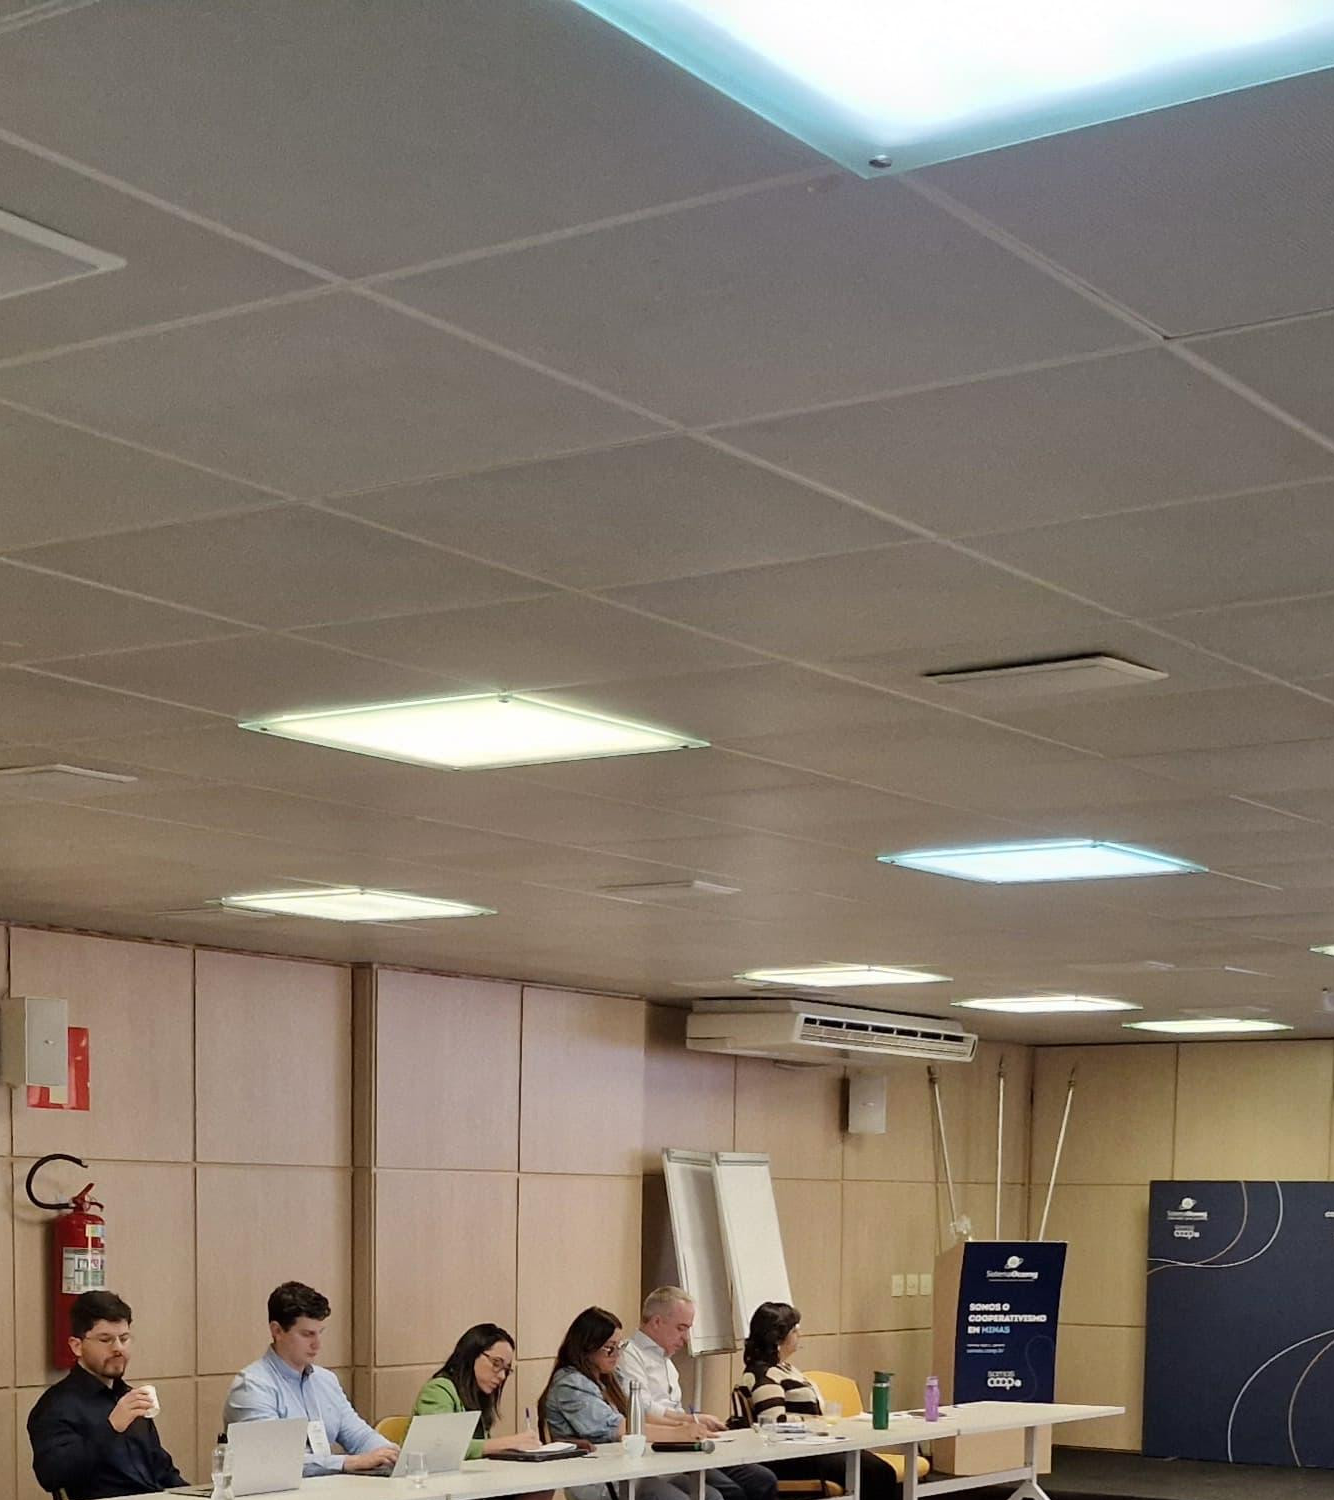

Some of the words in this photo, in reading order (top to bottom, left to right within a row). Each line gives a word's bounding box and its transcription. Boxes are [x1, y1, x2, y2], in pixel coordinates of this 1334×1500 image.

[969, 1303, 1001, 1312] SOMOS
[1002, 1303, 1010, 1312] O
[968, 1314, 1048, 1323] COOPERATIVISMO
